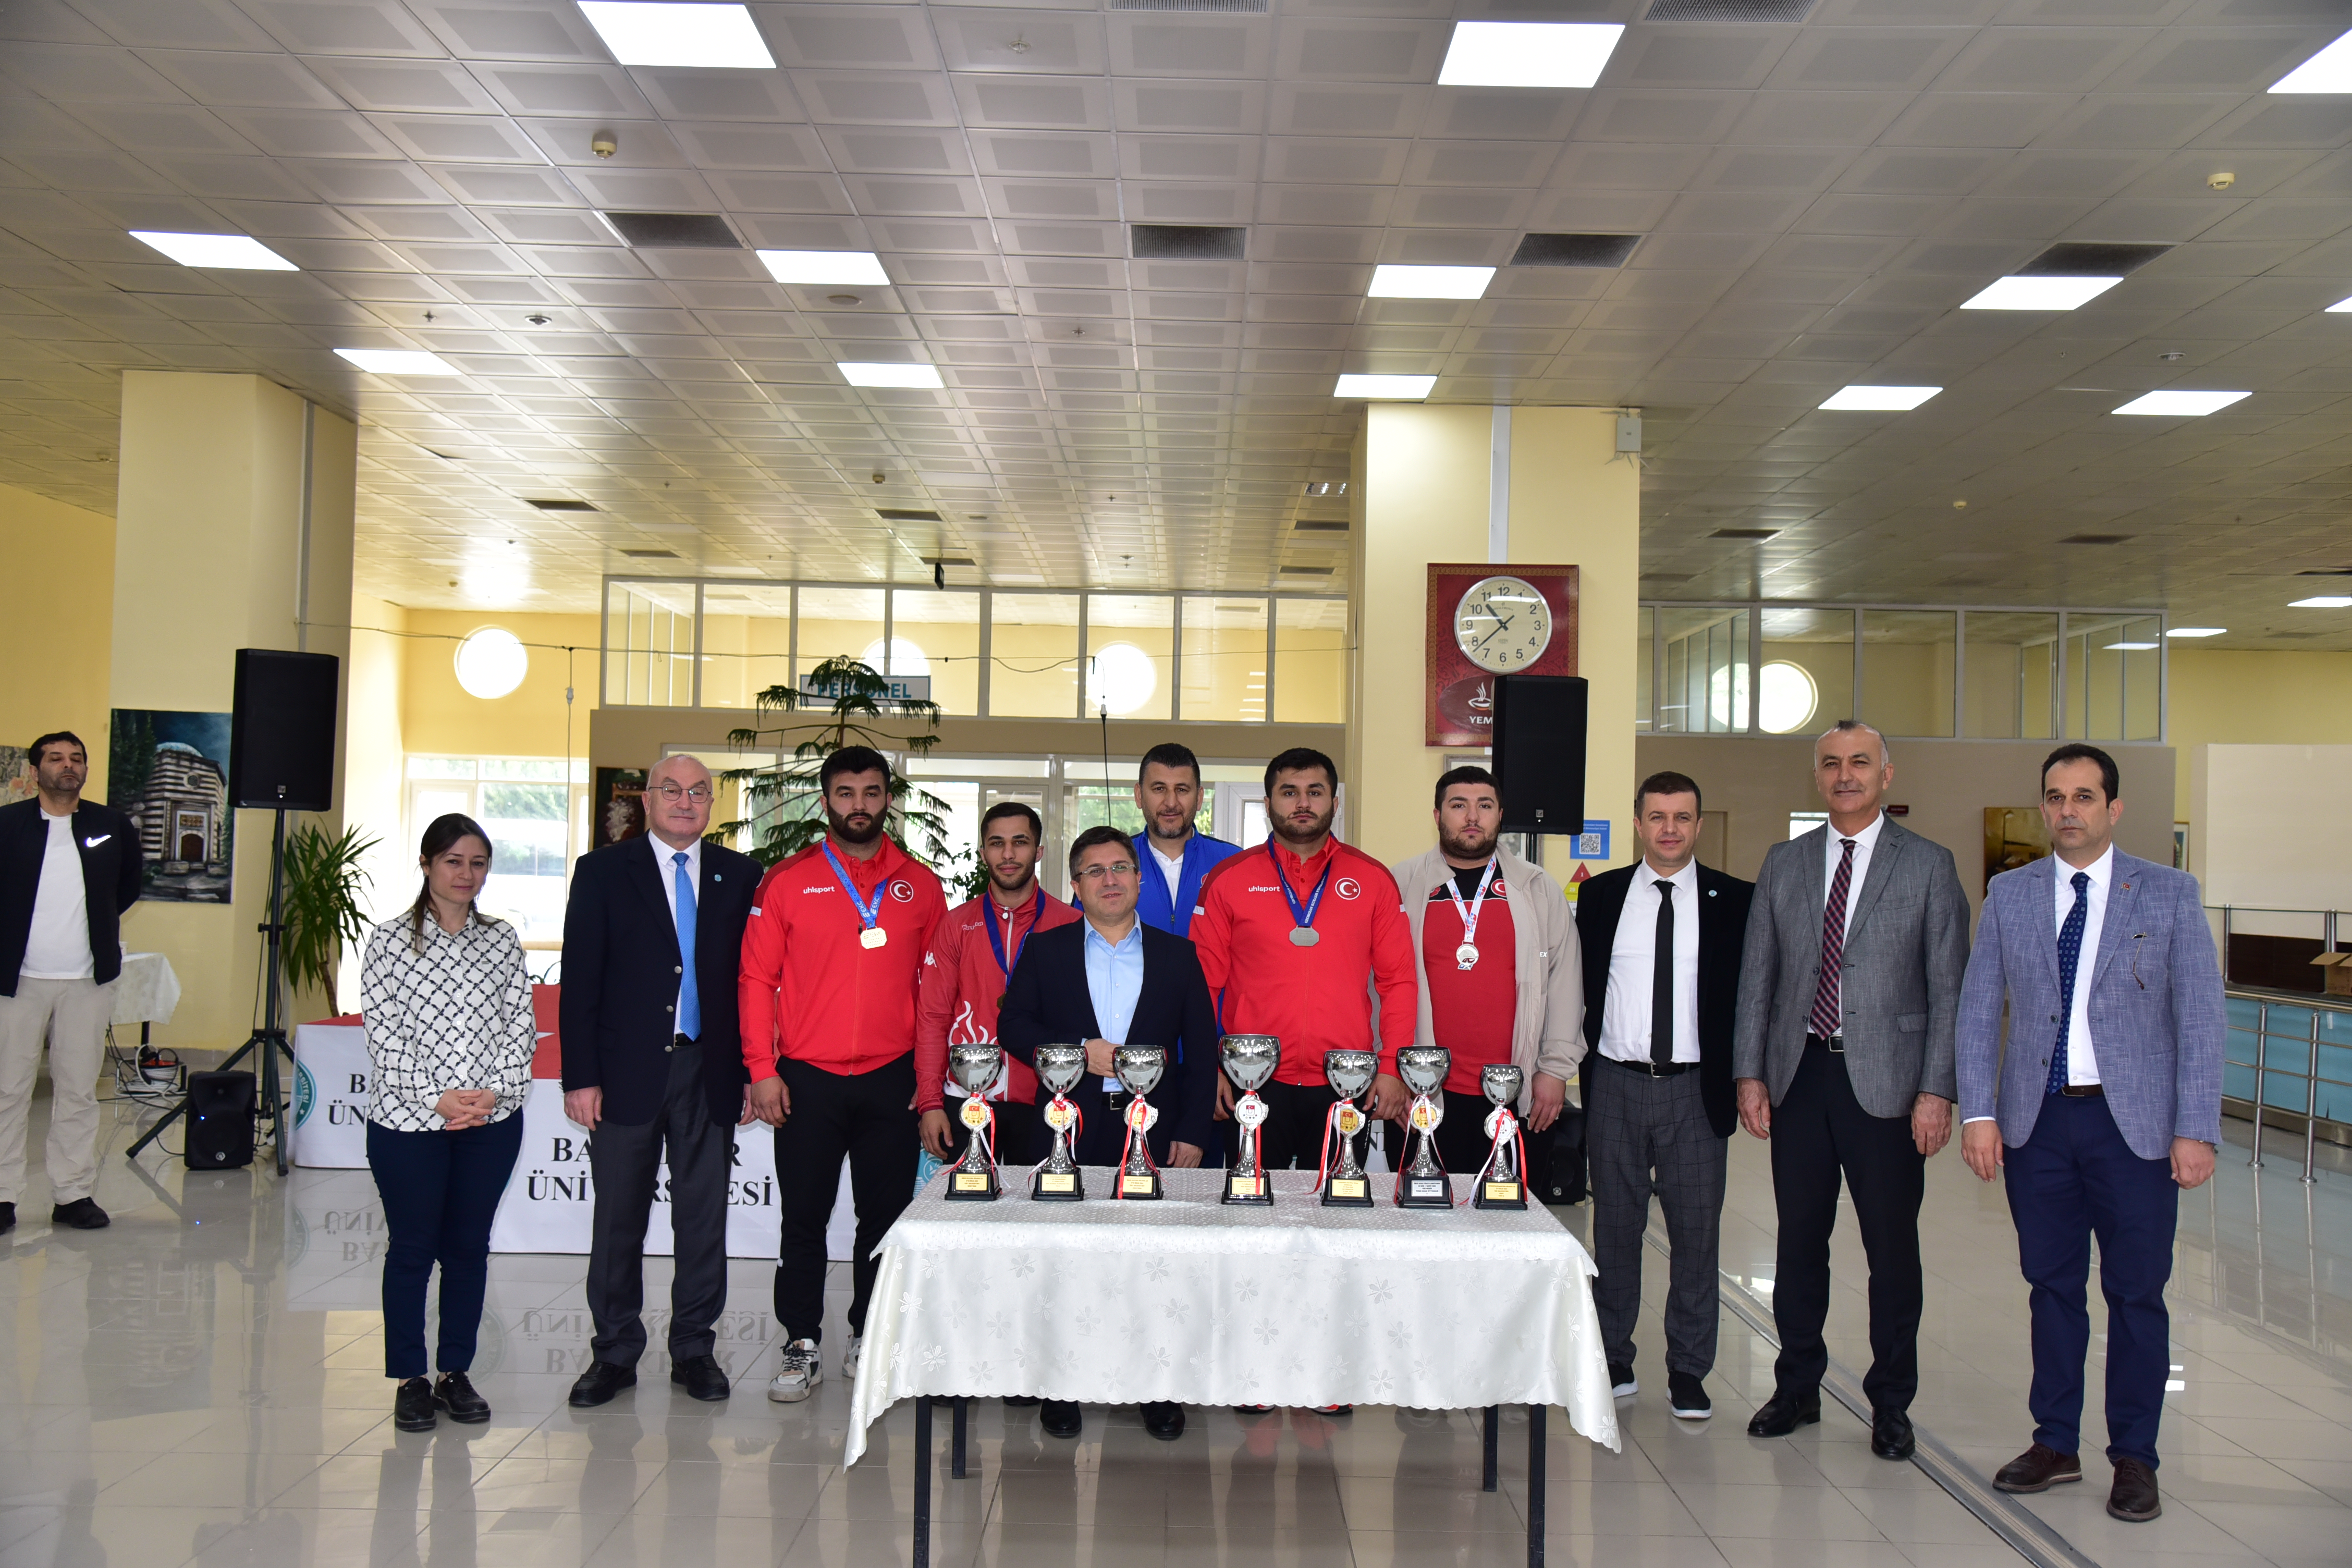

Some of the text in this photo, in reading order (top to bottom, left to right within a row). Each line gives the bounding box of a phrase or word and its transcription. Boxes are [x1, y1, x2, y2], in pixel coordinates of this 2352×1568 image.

[1498, 586, 1510, 596] 12
[1481, 592, 1491, 602] 11
[1470, 604, 1483, 615] 10
[1529, 604, 1537, 615] 2
[1466, 620, 1473, 630] 9
[1534, 620, 1541, 630] 3
[1471, 636, 1478, 646] 8
[1528, 636, 1536, 647] 4
[1483, 648, 1490, 658] 7
[1499, 652, 1506, 663] 6
[1516, 649, 1523, 659] 5
[1469, 716, 1492, 724] YEM
[803, 886, 835, 894] uhlsport
